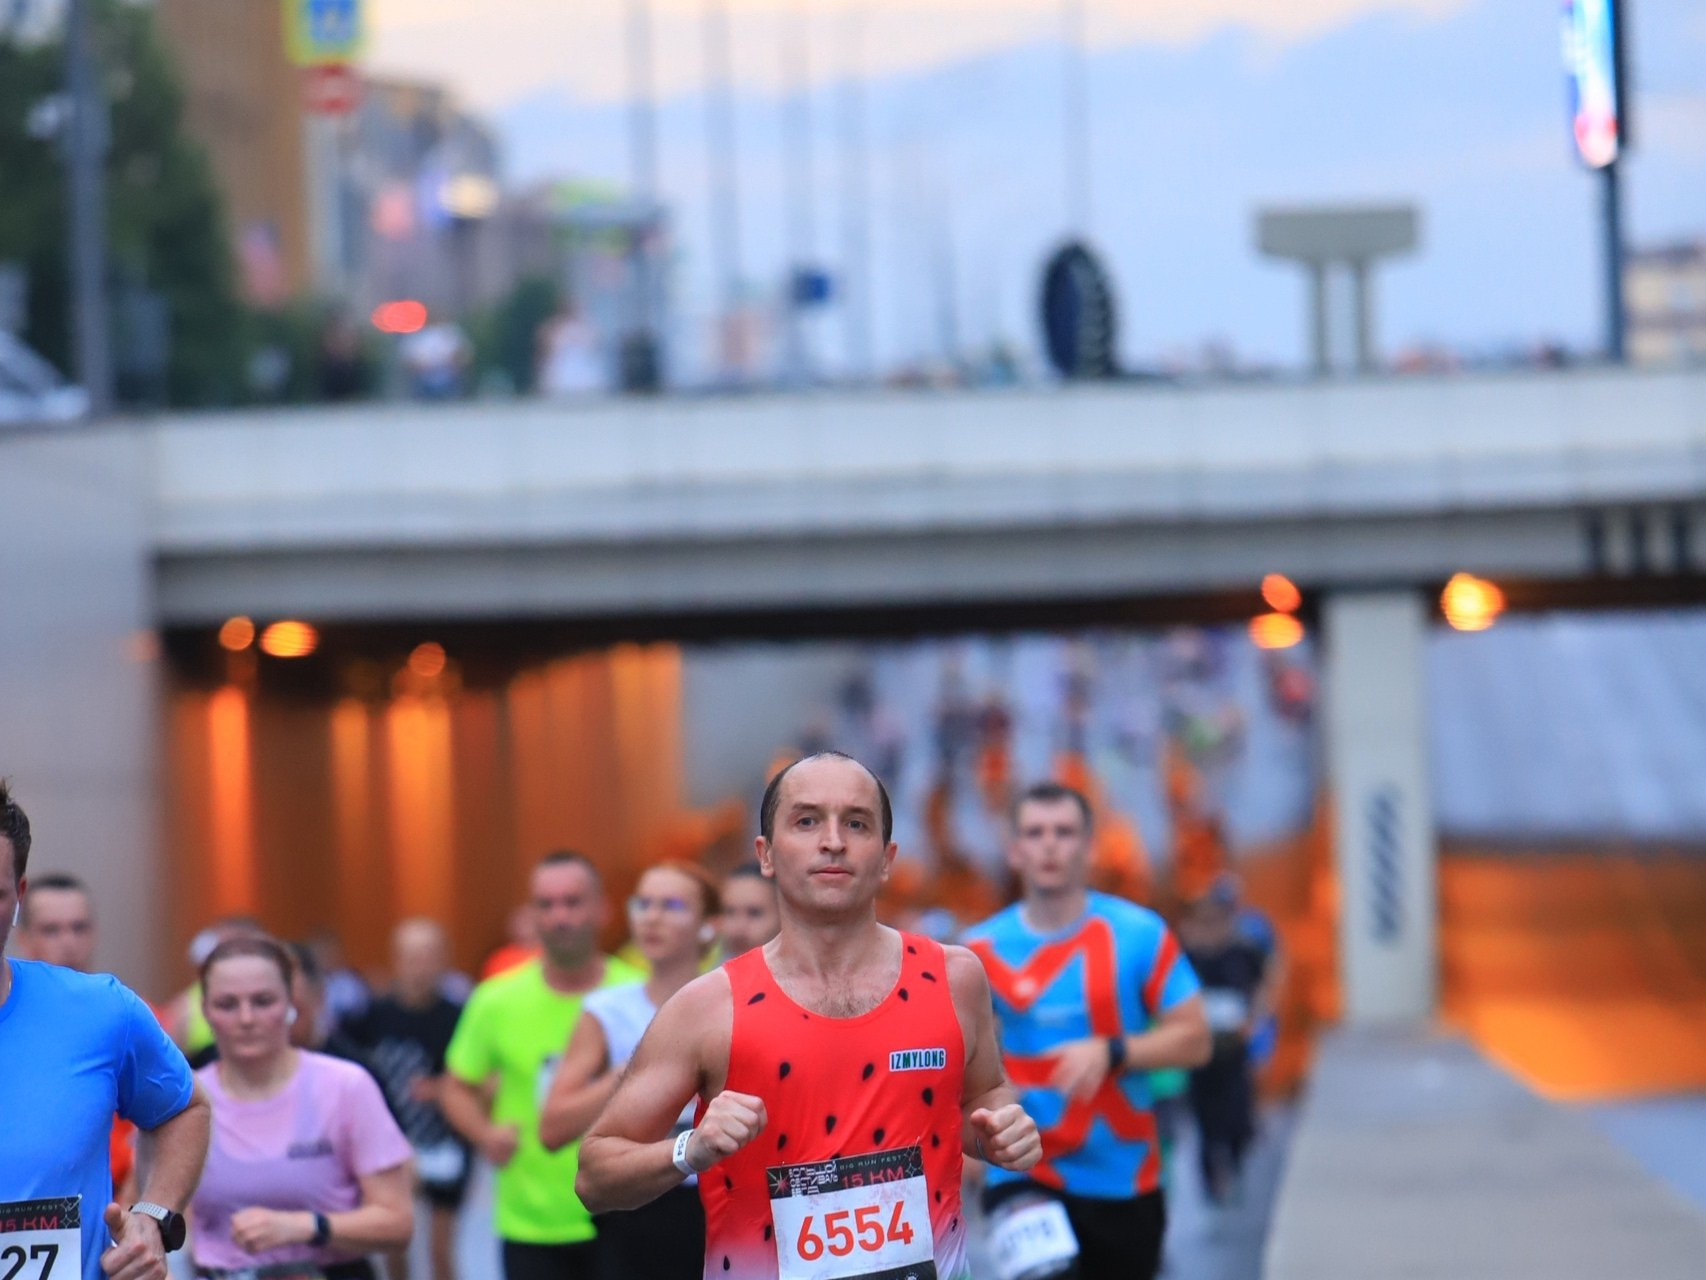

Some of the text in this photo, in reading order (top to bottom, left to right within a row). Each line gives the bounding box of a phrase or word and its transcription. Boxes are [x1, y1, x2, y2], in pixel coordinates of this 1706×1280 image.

[891, 1050, 945, 1070] IZMYLONG
[858, 1159, 877, 1167] RUN
[881, 1154, 903, 1163] FEST
[841, 1172, 864, 1189] 15
[797, 1200, 915, 1262] 6554
